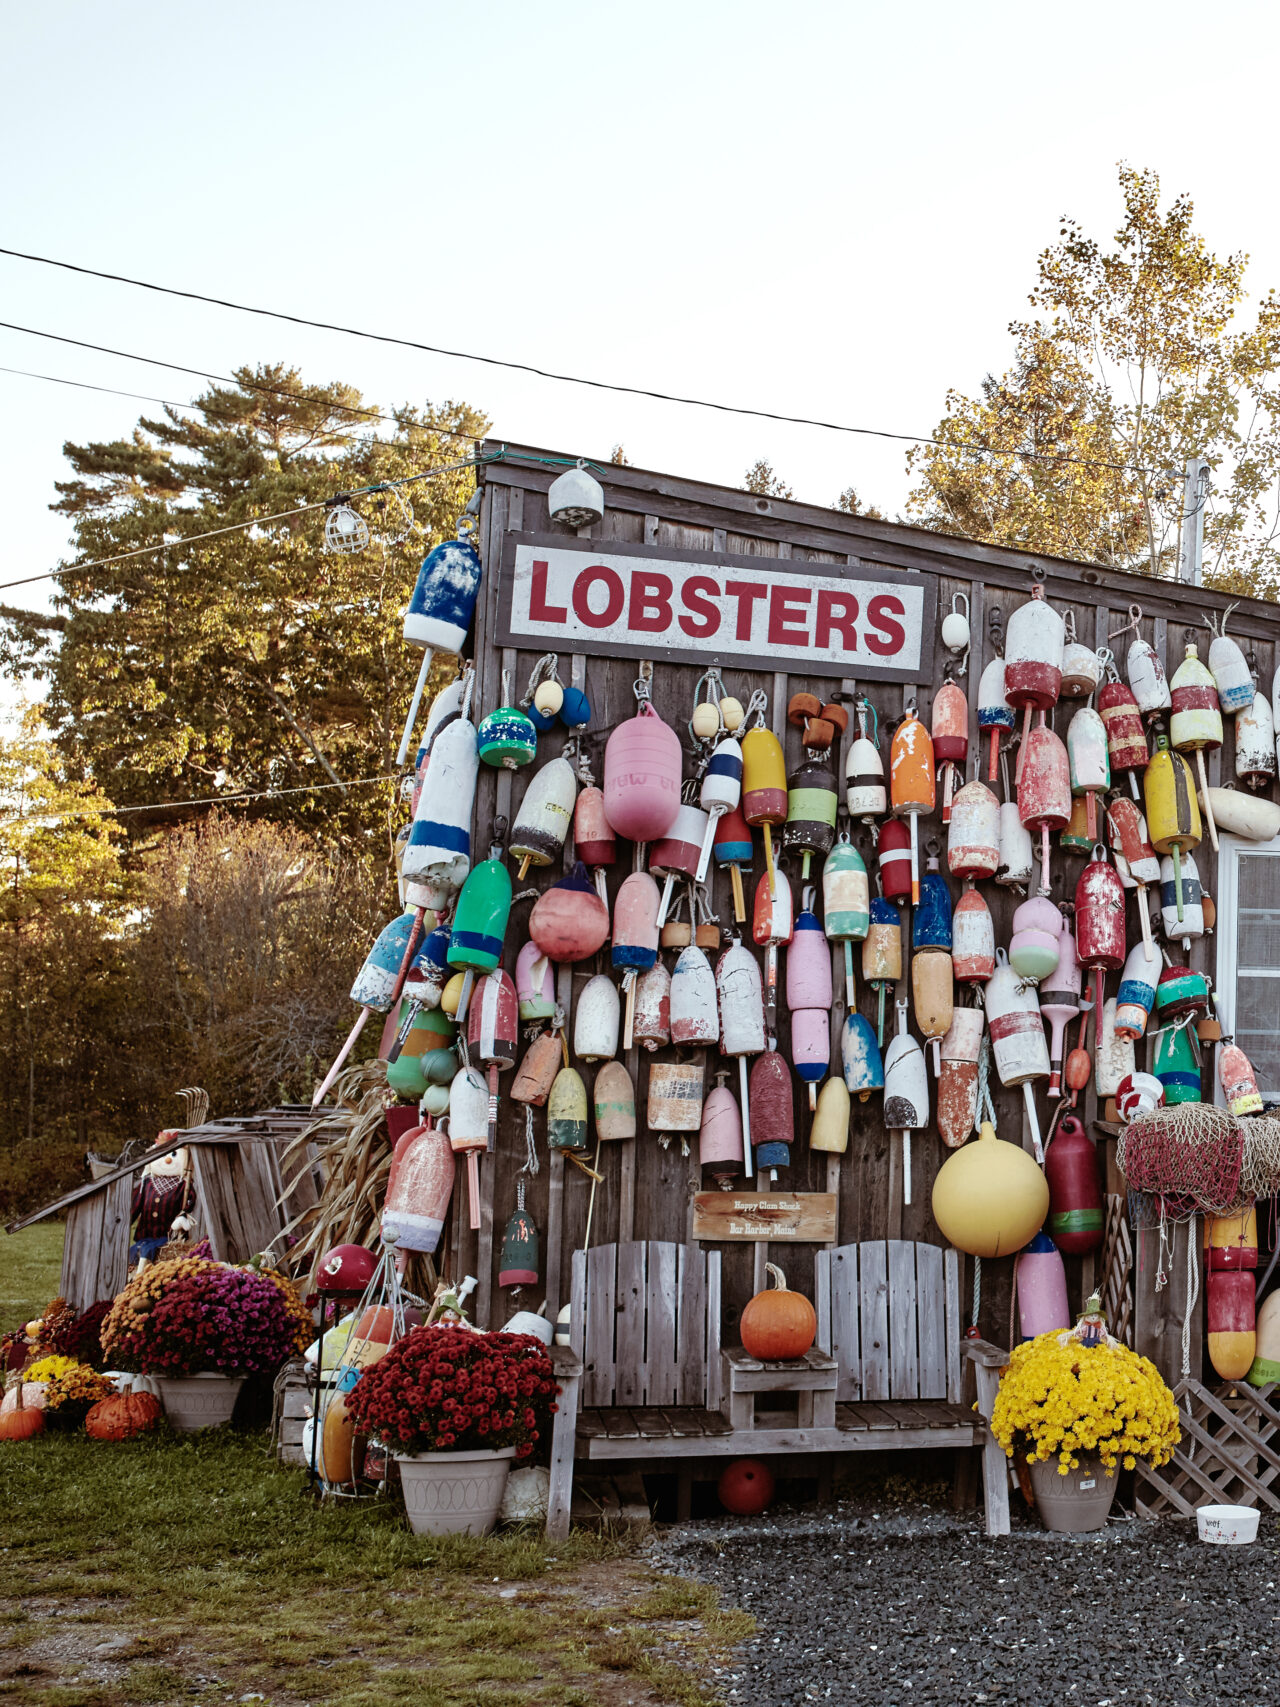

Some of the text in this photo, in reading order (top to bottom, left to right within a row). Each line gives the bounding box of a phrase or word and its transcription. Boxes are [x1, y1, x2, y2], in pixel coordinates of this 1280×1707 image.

[529, 560, 906, 656] LOBSTERS
[759, 1201, 777, 1209] Clam
[729, 1222, 744, 1234] Bar
